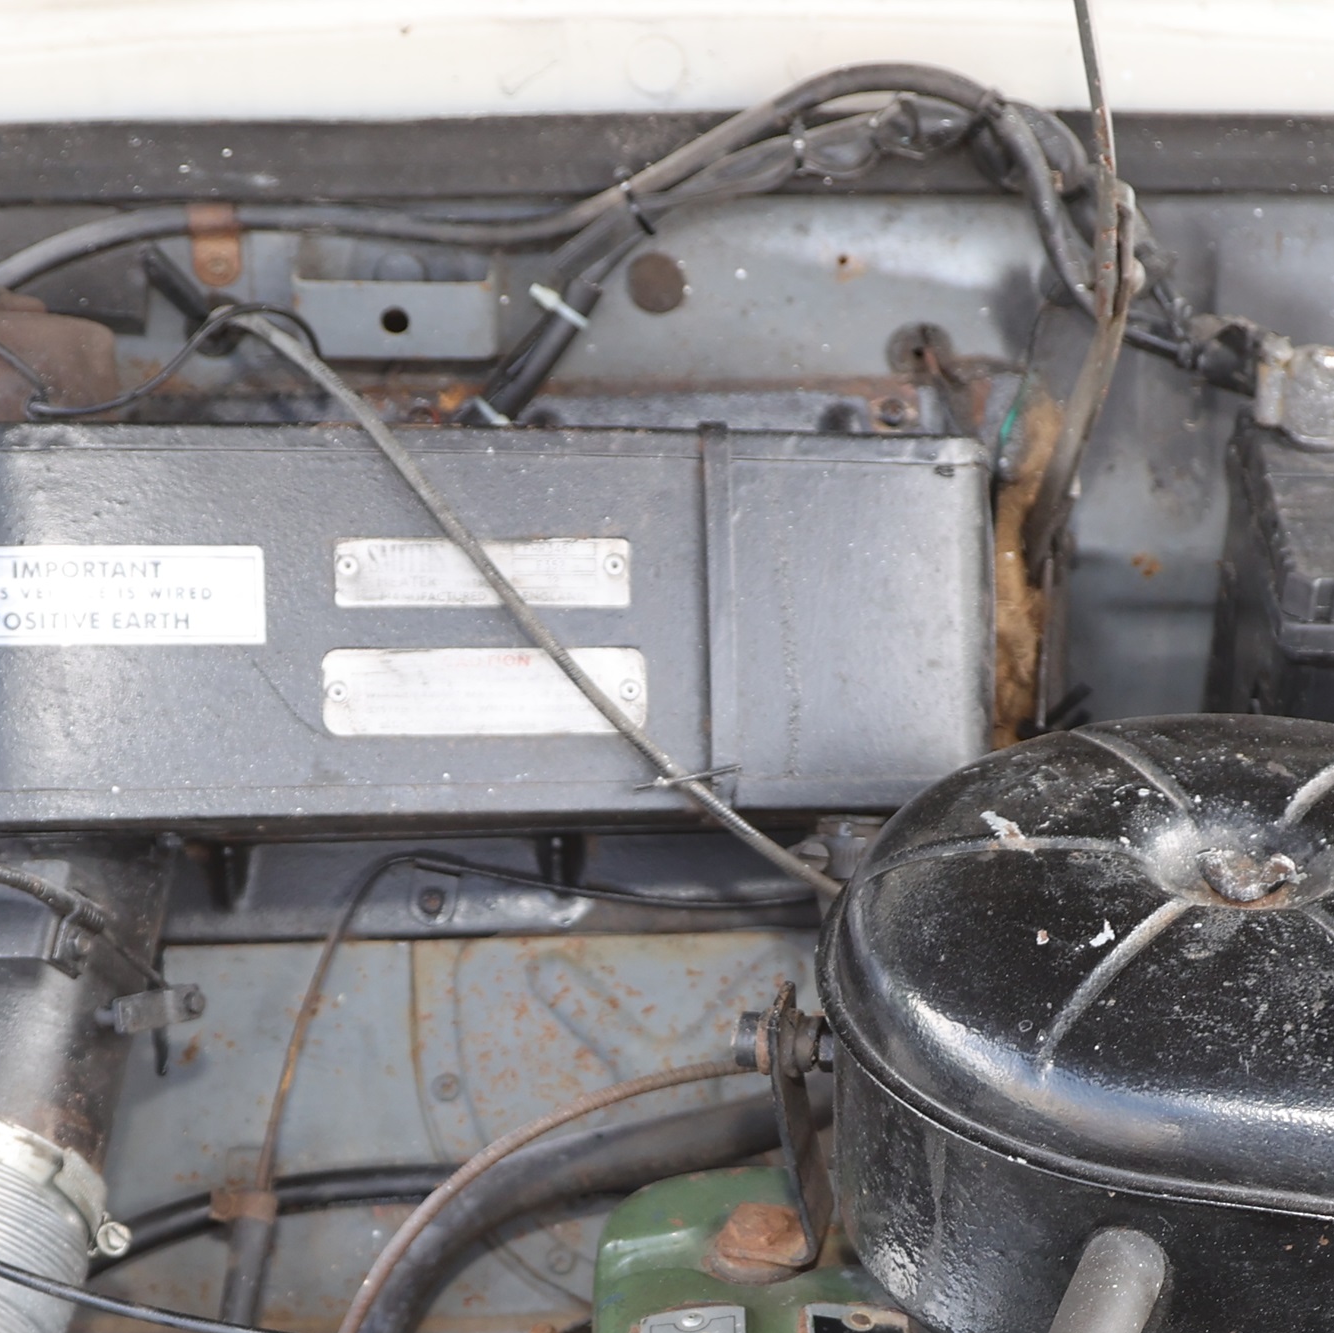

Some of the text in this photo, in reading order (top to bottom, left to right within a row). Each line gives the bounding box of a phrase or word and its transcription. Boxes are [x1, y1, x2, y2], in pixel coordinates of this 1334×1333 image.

[11, 560, 162, 580] IMPORTANT
[149, 587, 213, 601] WIRED
[112, 611, 191, 630] EARTH
